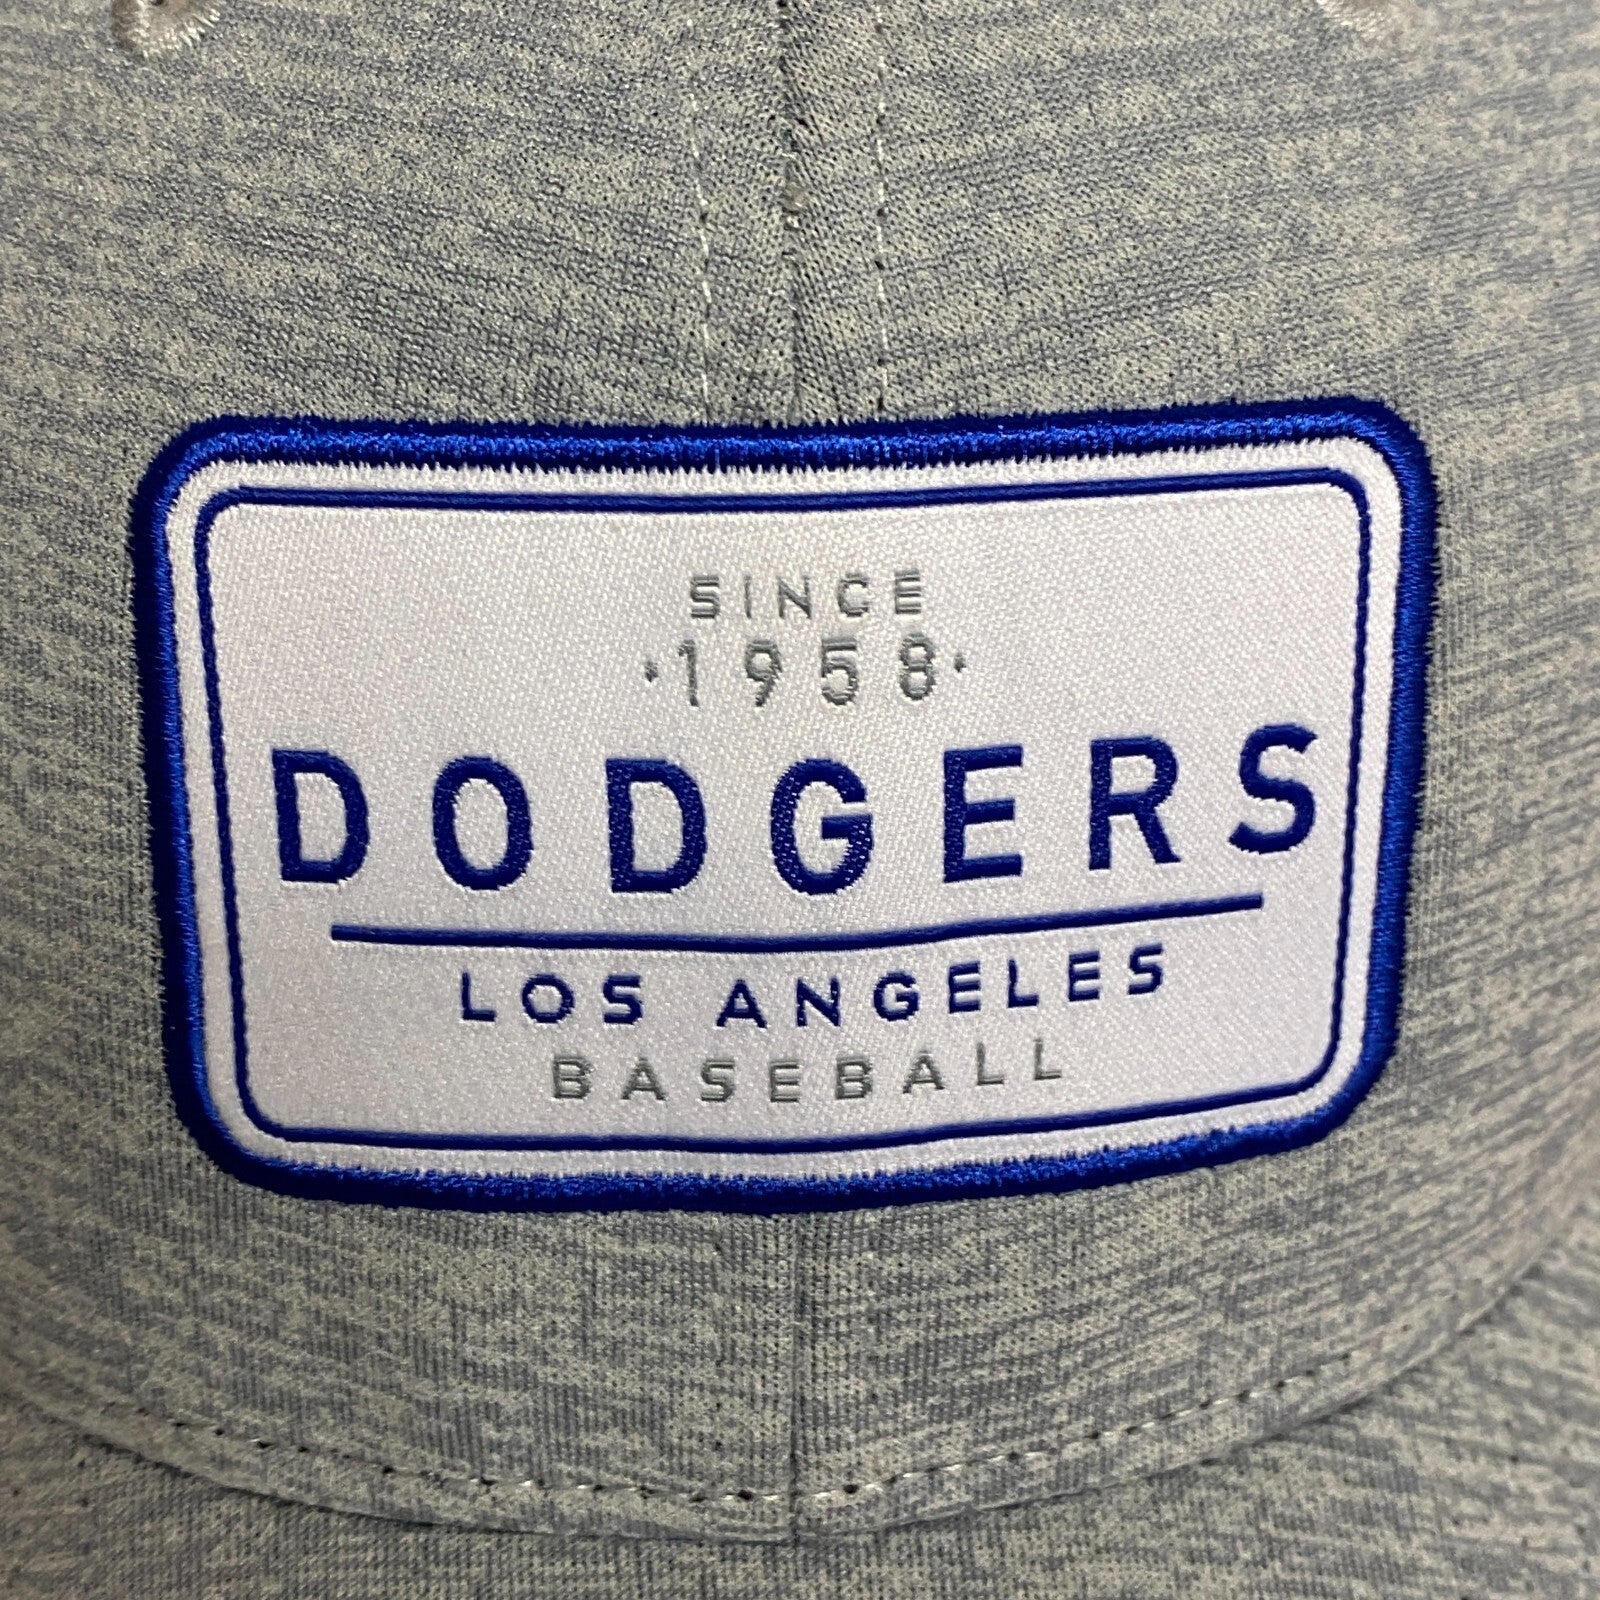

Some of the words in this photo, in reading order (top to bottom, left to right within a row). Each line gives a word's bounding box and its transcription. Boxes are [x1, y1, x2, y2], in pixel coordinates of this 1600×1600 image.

[689, 569, 923, 620] SINCE
[270, 723, 1319, 896] DODGERS
[459, 968, 645, 1025] LOS
[716, 942, 1165, 1028] ANGELES
[551, 1038, 1063, 1103] BASEBALL
